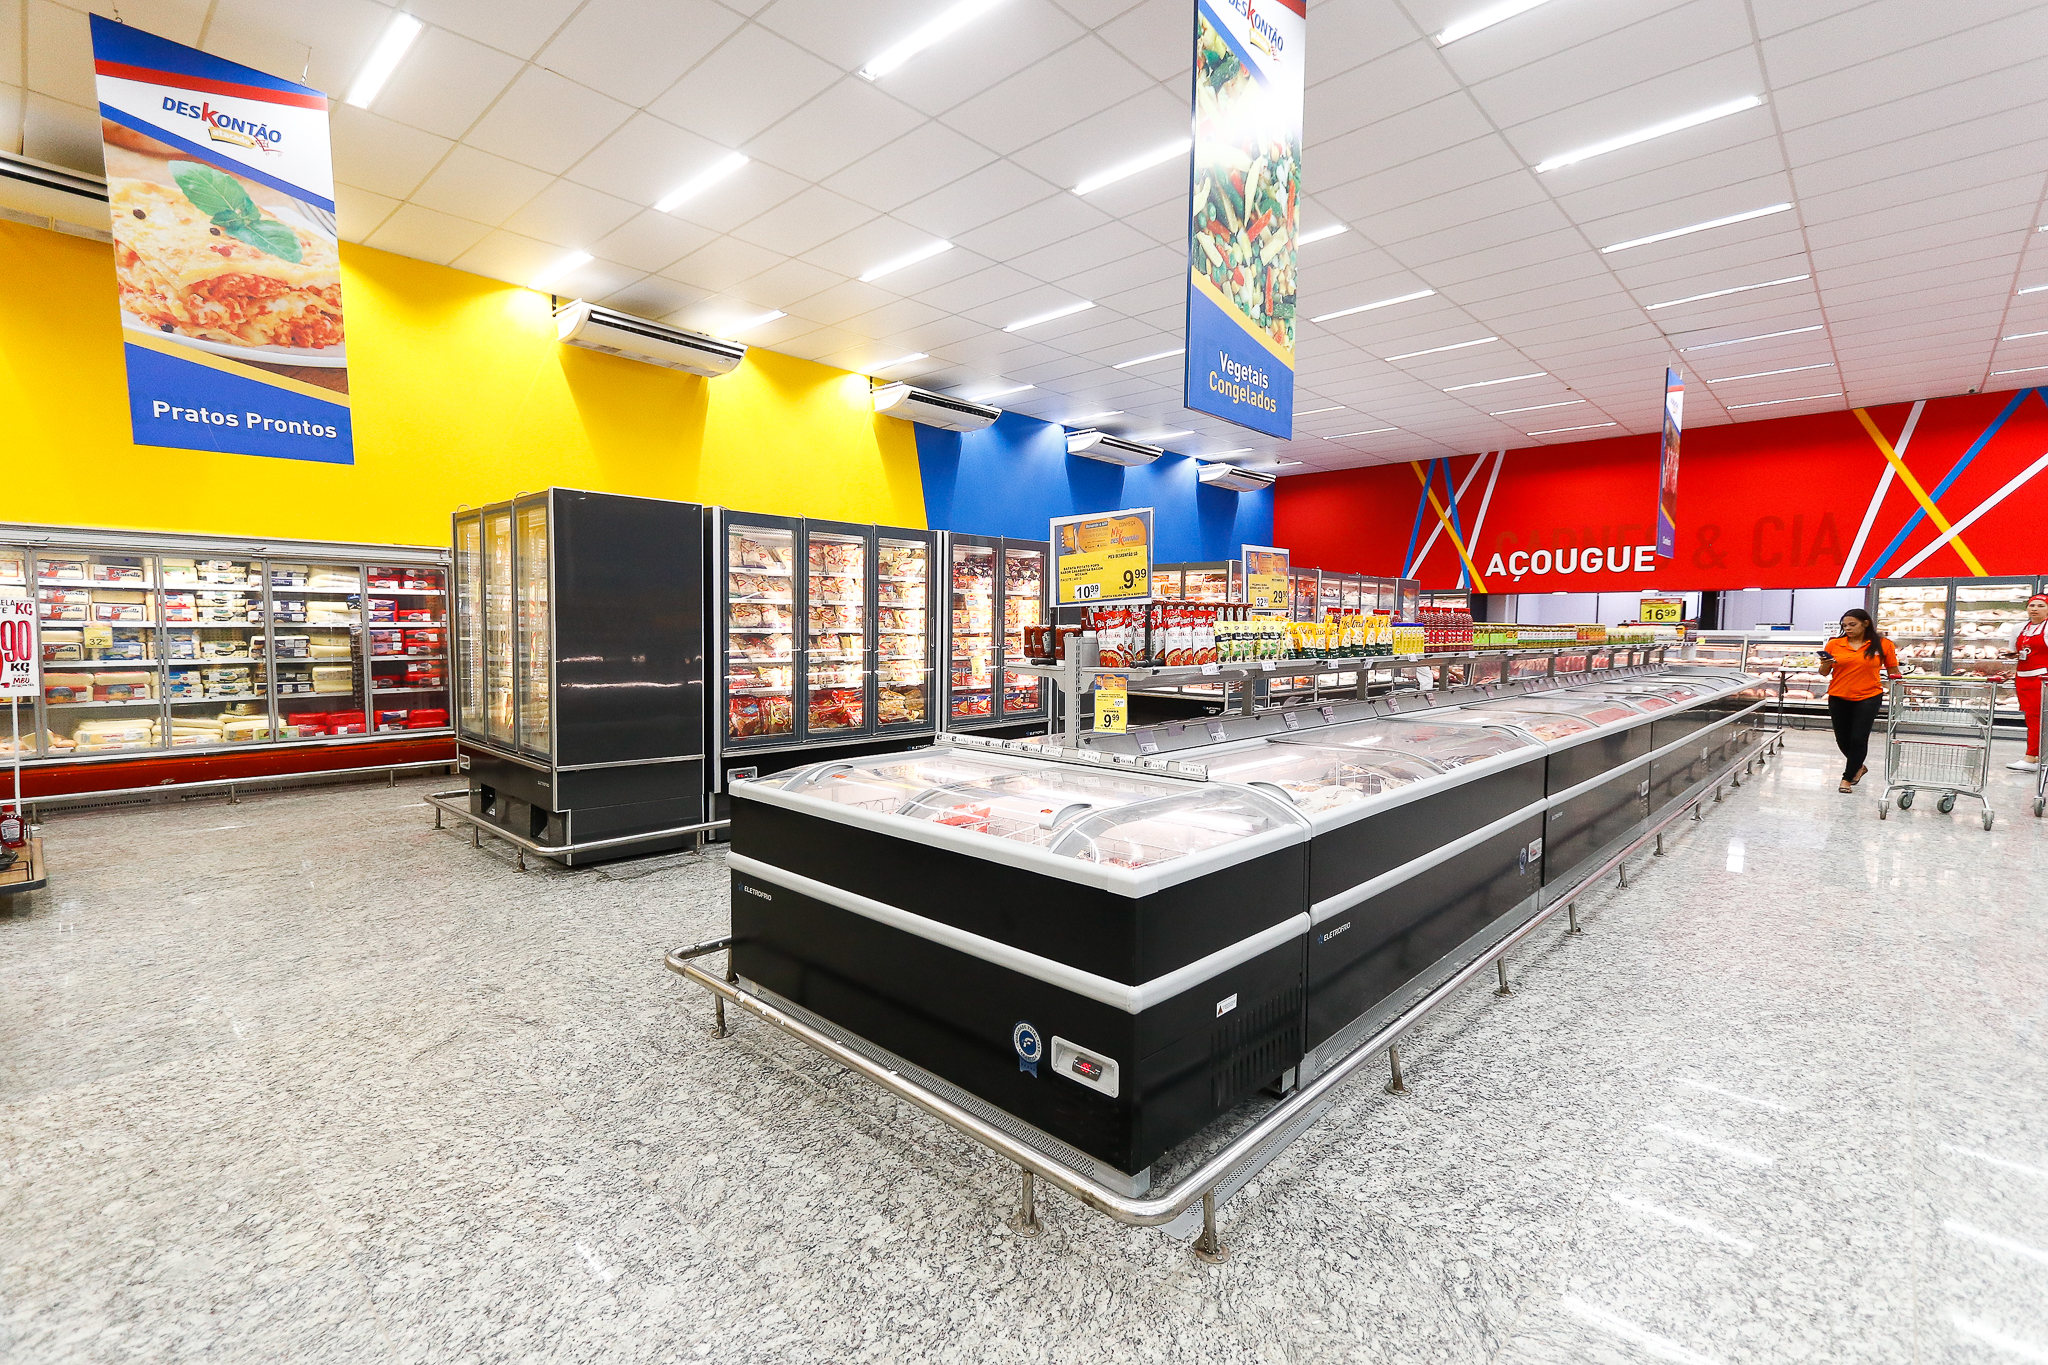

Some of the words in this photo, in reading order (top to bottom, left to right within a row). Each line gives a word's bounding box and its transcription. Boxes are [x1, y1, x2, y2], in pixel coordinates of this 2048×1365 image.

[162, 96, 282, 143] DESKONTÃO
[1219, 350, 1269, 389] Vegetais
[1209, 370, 1277, 413] Congelados
[152, 400, 240, 427] Pratos
[246, 411, 338, 439] Prontos
[1752, 511, 1844, 569] CIA
[1484, 545, 1657, 583] AÇOUGUE
[10, 662, 30, 674] KG
[744, 885, 772, 902] ELETROFRIO
[1323, 921, 1351, 942] ELETROFRIO
